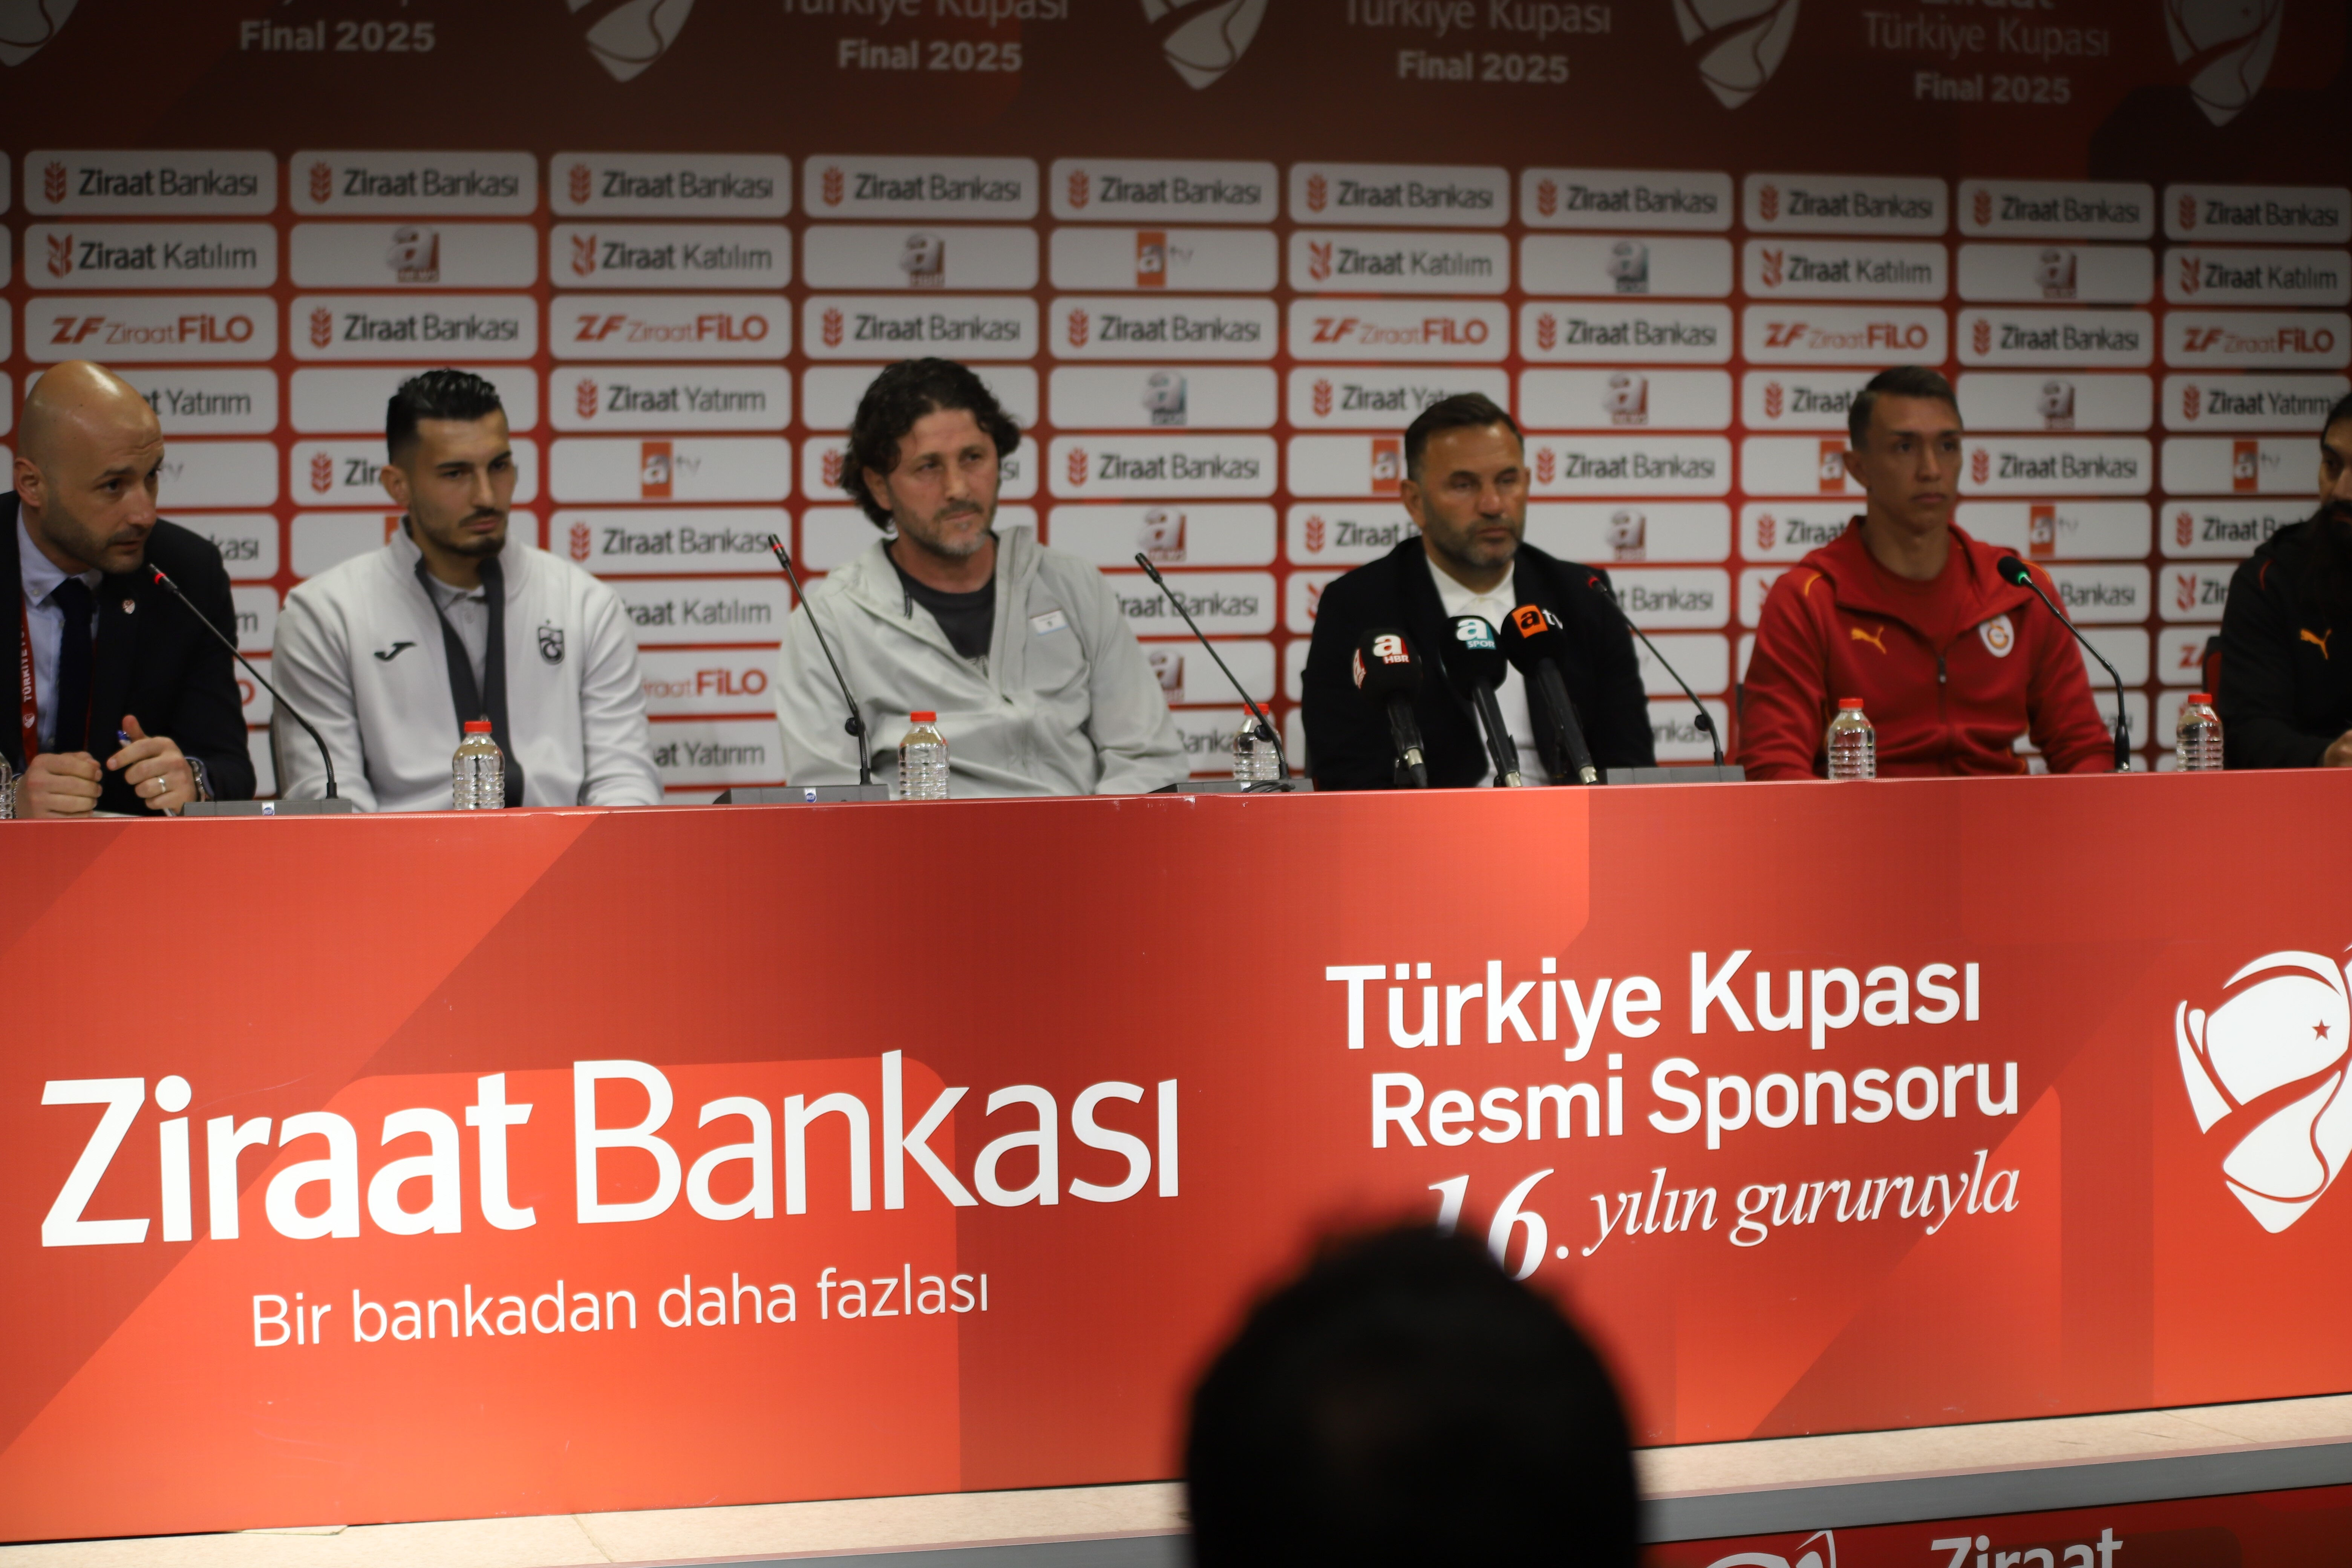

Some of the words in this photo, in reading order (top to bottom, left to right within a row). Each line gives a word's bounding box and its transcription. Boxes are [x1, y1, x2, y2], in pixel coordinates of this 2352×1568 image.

[240, 20, 325, 51] Final
[336, 21, 435, 52] 2025
[1862, 10, 1985, 60] Türkiye
[1998, 17, 2109, 62] Kupası
[838, 39, 919, 69] Final
[928, 41, 1022, 72] 2025
[1398, 50, 1473, 80] Final
[1482, 53, 1568, 83] 2025
[1914, 72, 1983, 101] Final
[1991, 75, 2070, 104] 2025
[78, 168, 154, 196] Ziraat
[158, 168, 257, 196] Bankası
[343, 168, 418, 196] Ziraat
[422, 168, 519, 197] Bankası
[602, 169, 674, 198] Ziraat
[678, 170, 773, 199] Bankası
[854, 173, 925, 201] Ziraat
[929, 173, 1021, 201] Bankası
[1099, 175, 1168, 204] Ziraat
[1172, 176, 1261, 205] Bankası
[1337, 179, 1403, 207] Ziraat
[1407, 181, 1493, 209] Bankası
[1566, 185, 1632, 212] Ziraat
[1634, 186, 1718, 214] Bankası
[1788, 190, 1850, 217] Ziraat
[1853, 191, 1933, 219] Bankası
[2001, 195, 2061, 222] Ziraat
[2063, 196, 2140, 223] Bankası
[2205, 200, 2263, 226] Ziraat
[2266, 201, 2339, 227] Bankası
[78, 241, 155, 270] Ziraat
[602, 241, 675, 270] Ziraat
[1337, 248, 1404, 275] Ziraat
[1788, 255, 1850, 282] Ziraat
[2205, 262, 2263, 289] Ziraat
[344, 313, 417, 341] Ziraat
[422, 313, 519, 341] Bankası
[854, 314, 924, 341] Ziraat
[929, 313, 1020, 341] Bankası
[1099, 314, 1167, 341] Ziraat
[1170, 314, 1260, 342] Bankası
[1566, 319, 1629, 345] Ziraat
[1634, 319, 1717, 346] Bankası
[2000, 324, 2059, 350] Ziraat
[2063, 325, 2139, 351] Bankası
[608, 384, 679, 412] Ziraat
[1341, 384, 1406, 411] Ziraat
[2208, 390, 2265, 415] Ziraat
[1098, 453, 1166, 480] Ziraat
[1171, 453, 1259, 479] Bankası
[1565, 452, 1628, 479] Ziraat
[1632, 453, 1715, 479] Bankası
[1999, 453, 2057, 479] Ziraat
[2061, 454, 2138, 479] Bankası
[602, 528, 673, 555] Ziraat
[2202, 517, 2259, 541] Ziraat
[1631, 586, 1713, 611] Bankası
[2059, 583, 2135, 606] Bankası
[1467, 640, 1495, 649] SPOR
[1384, 655, 1410, 664] HBR
[1326, 957, 1661, 1061] Türkiye
[1690, 949, 1979, 1050] Kupası
[1372, 1054, 1623, 1148] Resmi
[1648, 1057, 2018, 1153] Sponsoru
[41, 1072, 537, 1247] Ziraat
[573, 1049, 1178, 1224] Bankası
[1582, 1167, 1717, 1257] yılın
[1729, 1149, 2020, 1247] gururuyla
[253, 1292, 331, 1347] Bir
[353, 1280, 636, 1342] bankadan
[658, 1272, 796, 1328] daha
[816, 1263, 987, 1320] fazlası
